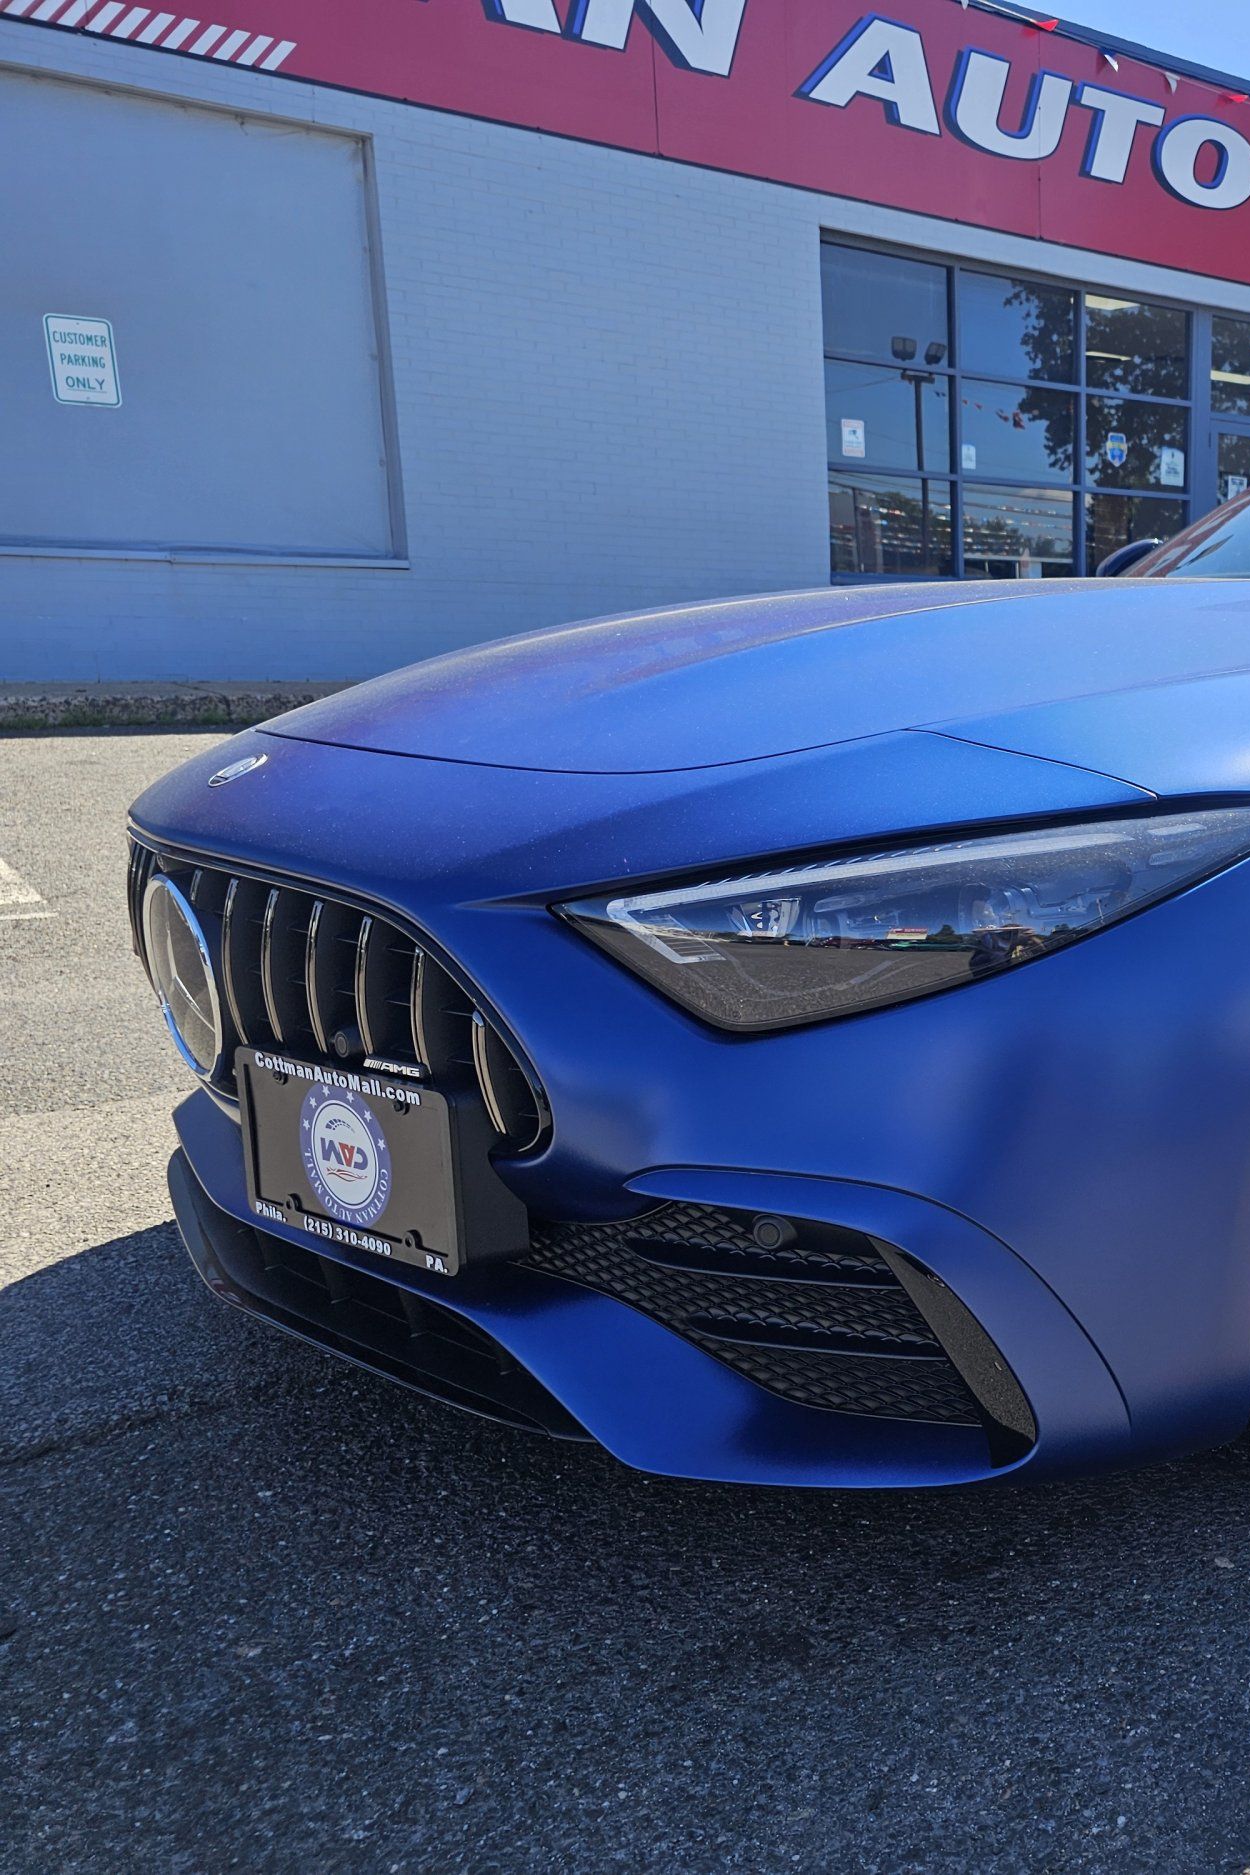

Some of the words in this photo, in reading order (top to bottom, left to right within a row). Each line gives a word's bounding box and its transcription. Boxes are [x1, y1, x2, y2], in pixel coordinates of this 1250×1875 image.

[52, 330, 108, 348] CUSTOMER
[60, 353, 106, 369] PARKING
[65, 375, 105, 390] ONLY
[254, 1051, 422, 1107] CottmanAutoMall.com
[380, 1061, 421, 1078] AMG
[320, 1136, 369, 1171] CAM
[303, 1147, 325, 1196] MALL
[324, 1195, 353, 1223] AUTO
[355, 1168, 389, 1223] COTTMAN
[255, 1201, 288, 1223] Phila.
[303, 1215, 333, 1239] (215)
[336, 1226, 392, 1257] 310-4090
[425, 1253, 449, 1274] PA.
